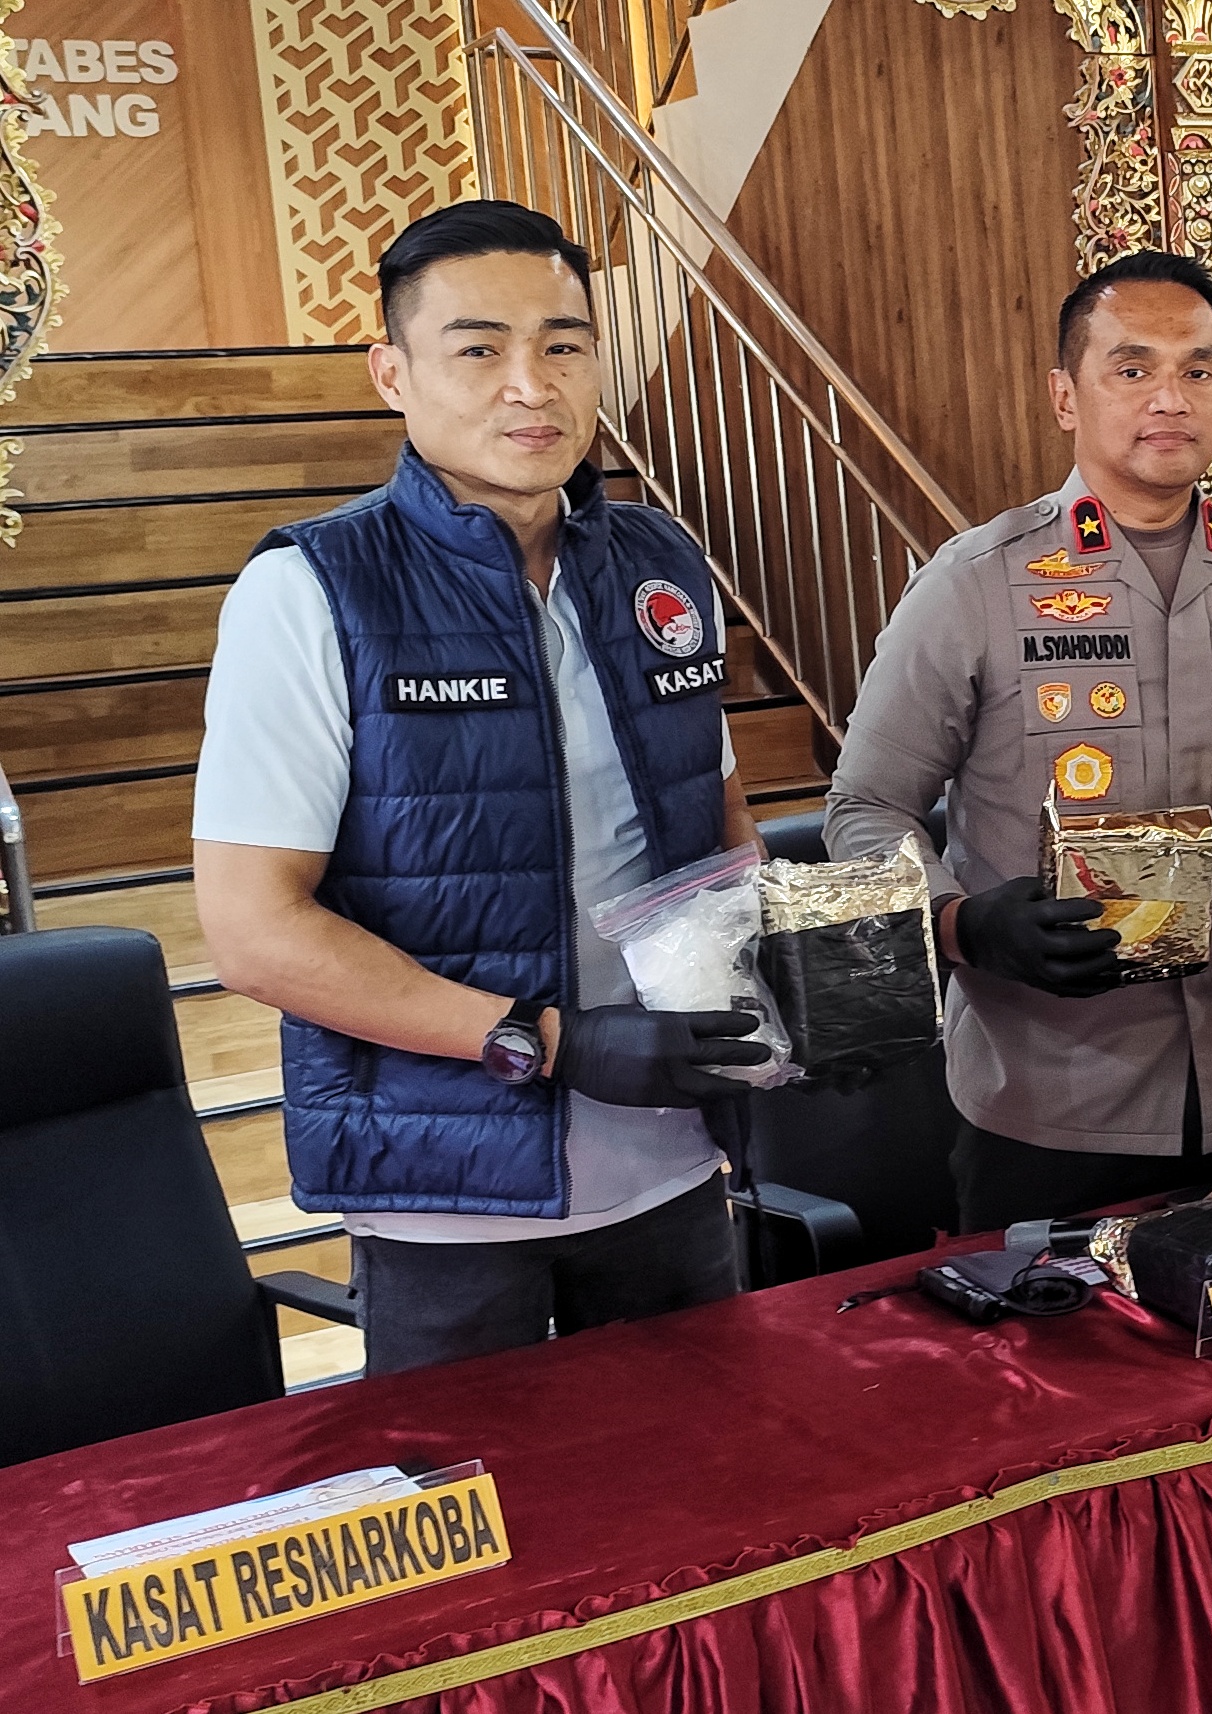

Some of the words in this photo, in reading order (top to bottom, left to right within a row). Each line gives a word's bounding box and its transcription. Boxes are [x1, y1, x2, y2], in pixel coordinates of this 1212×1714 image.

[397, 677, 509, 703] HANKIE
[653, 658, 726, 696] KASAT
[81, 1559, 224, 1666] KASAT
[230, 1488, 500, 1624] RESNARKOBA
